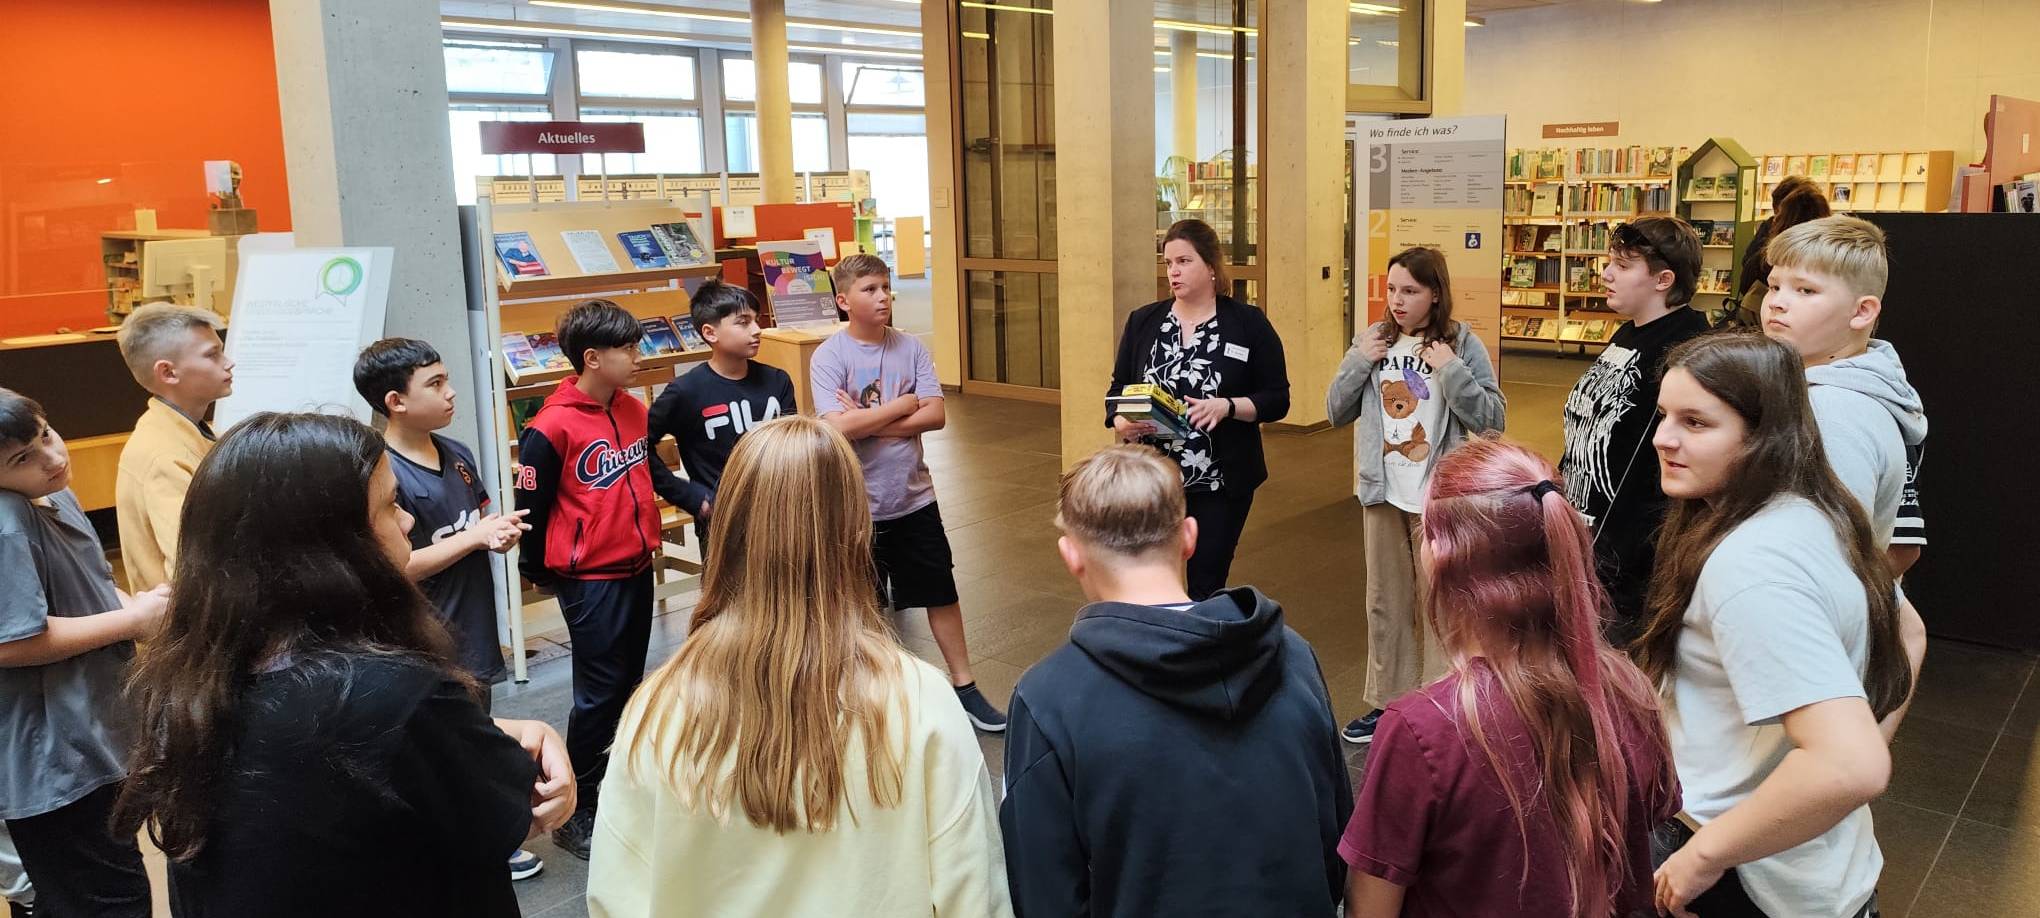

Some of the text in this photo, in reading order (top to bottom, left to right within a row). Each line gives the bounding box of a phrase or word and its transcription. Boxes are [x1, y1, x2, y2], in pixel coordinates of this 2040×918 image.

[538, 132, 596, 145] Aktuelles
[1370, 125, 1458, 138] Wo finde ich was?
[1370, 144, 1388, 173] 3
[1369, 209, 1388, 238] 2
[765, 258, 795, 267] KULTUR
[781, 265, 811, 274] BEWEGT
[1368, 274, 1385, 302] 1
[1379, 355, 1433, 375] PARIS
[702, 396, 781, 440] FILA
[575, 436, 648, 488] Chicag
